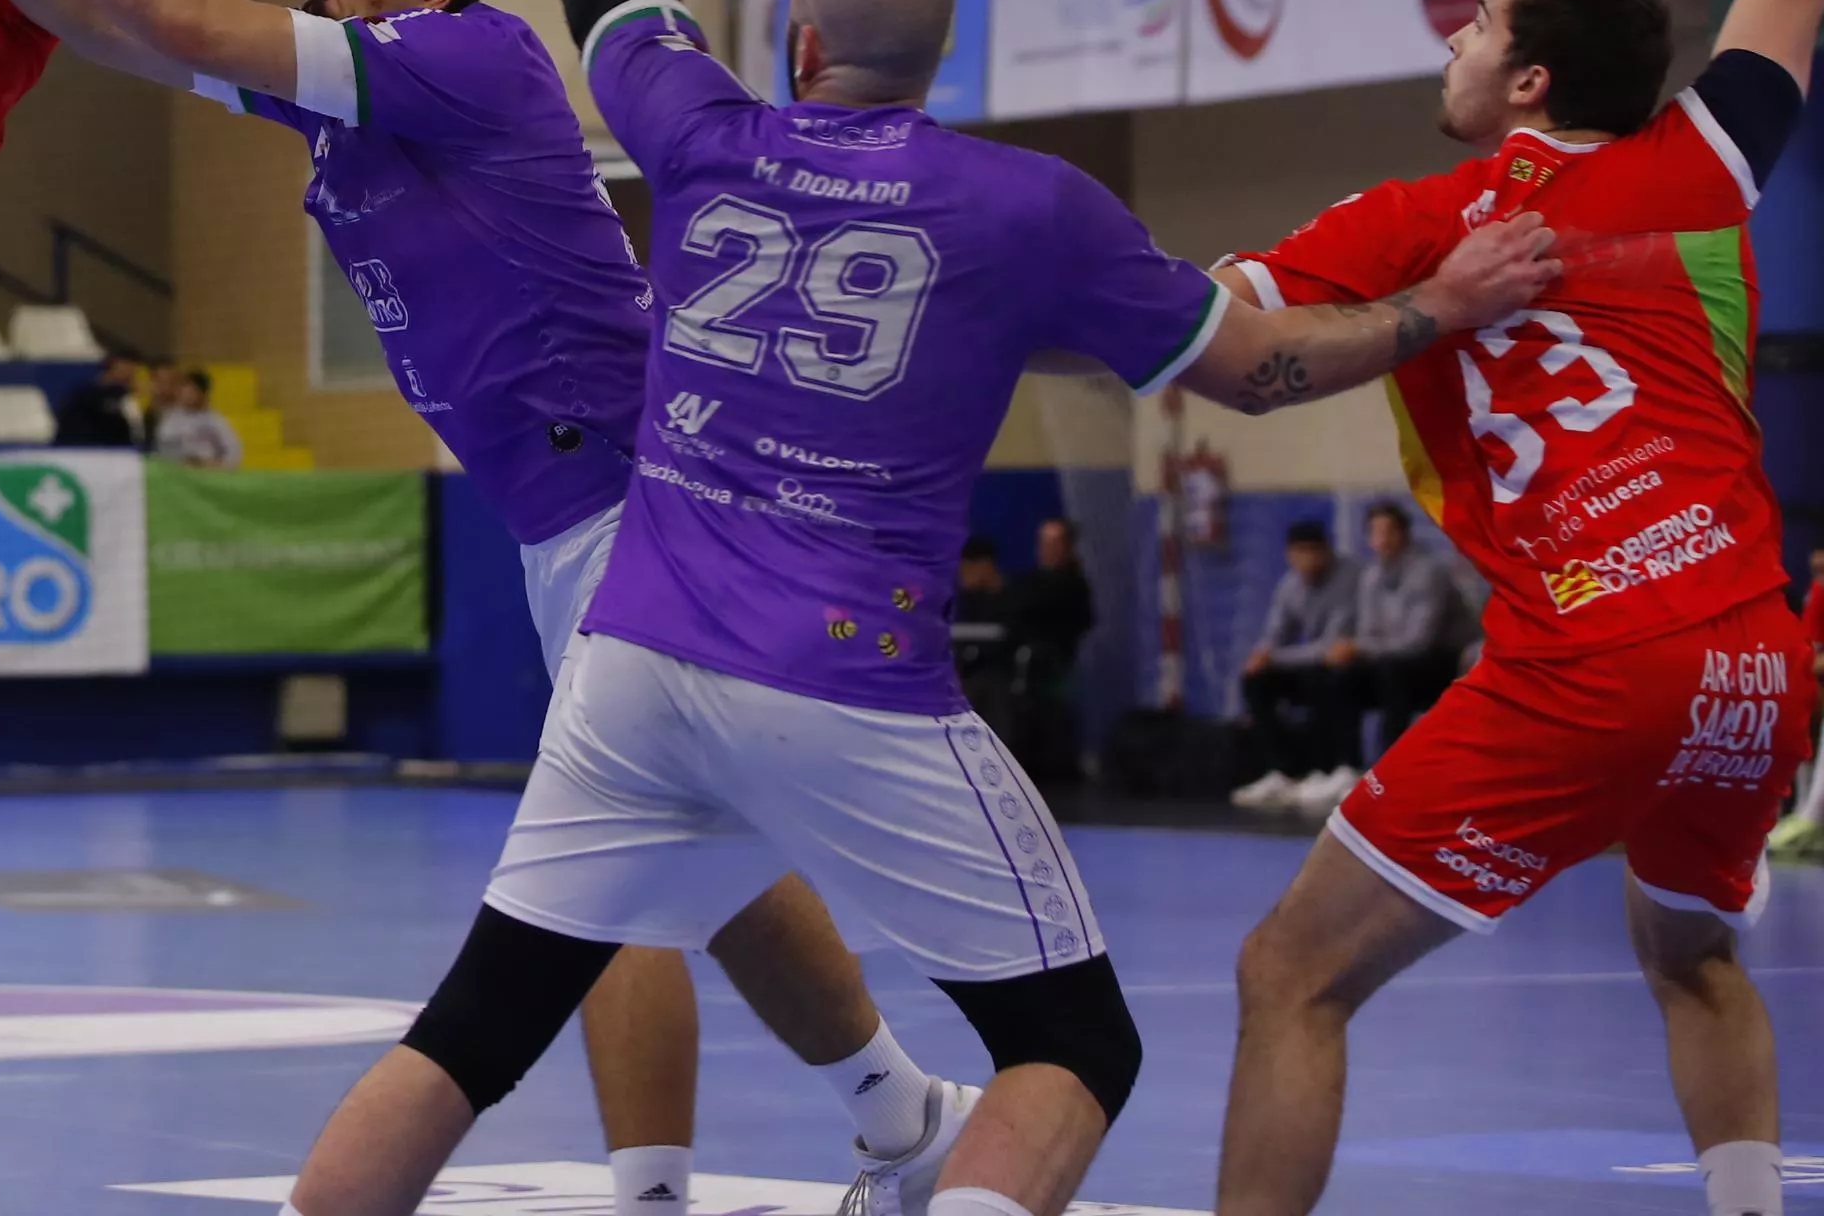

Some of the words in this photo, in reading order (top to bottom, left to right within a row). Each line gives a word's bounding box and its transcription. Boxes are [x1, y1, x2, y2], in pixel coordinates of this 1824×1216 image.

[752, 156, 782, 185] M.
[787, 168, 911, 207] DORADO
[663, 192, 941, 402] 29
[1543, 435, 1675, 522] Ayuntamiento
[1559, 516, 1584, 542] de
[1581, 470, 1663, 518] Huesca
[1700, 642, 1787, 696] ARGÓN
